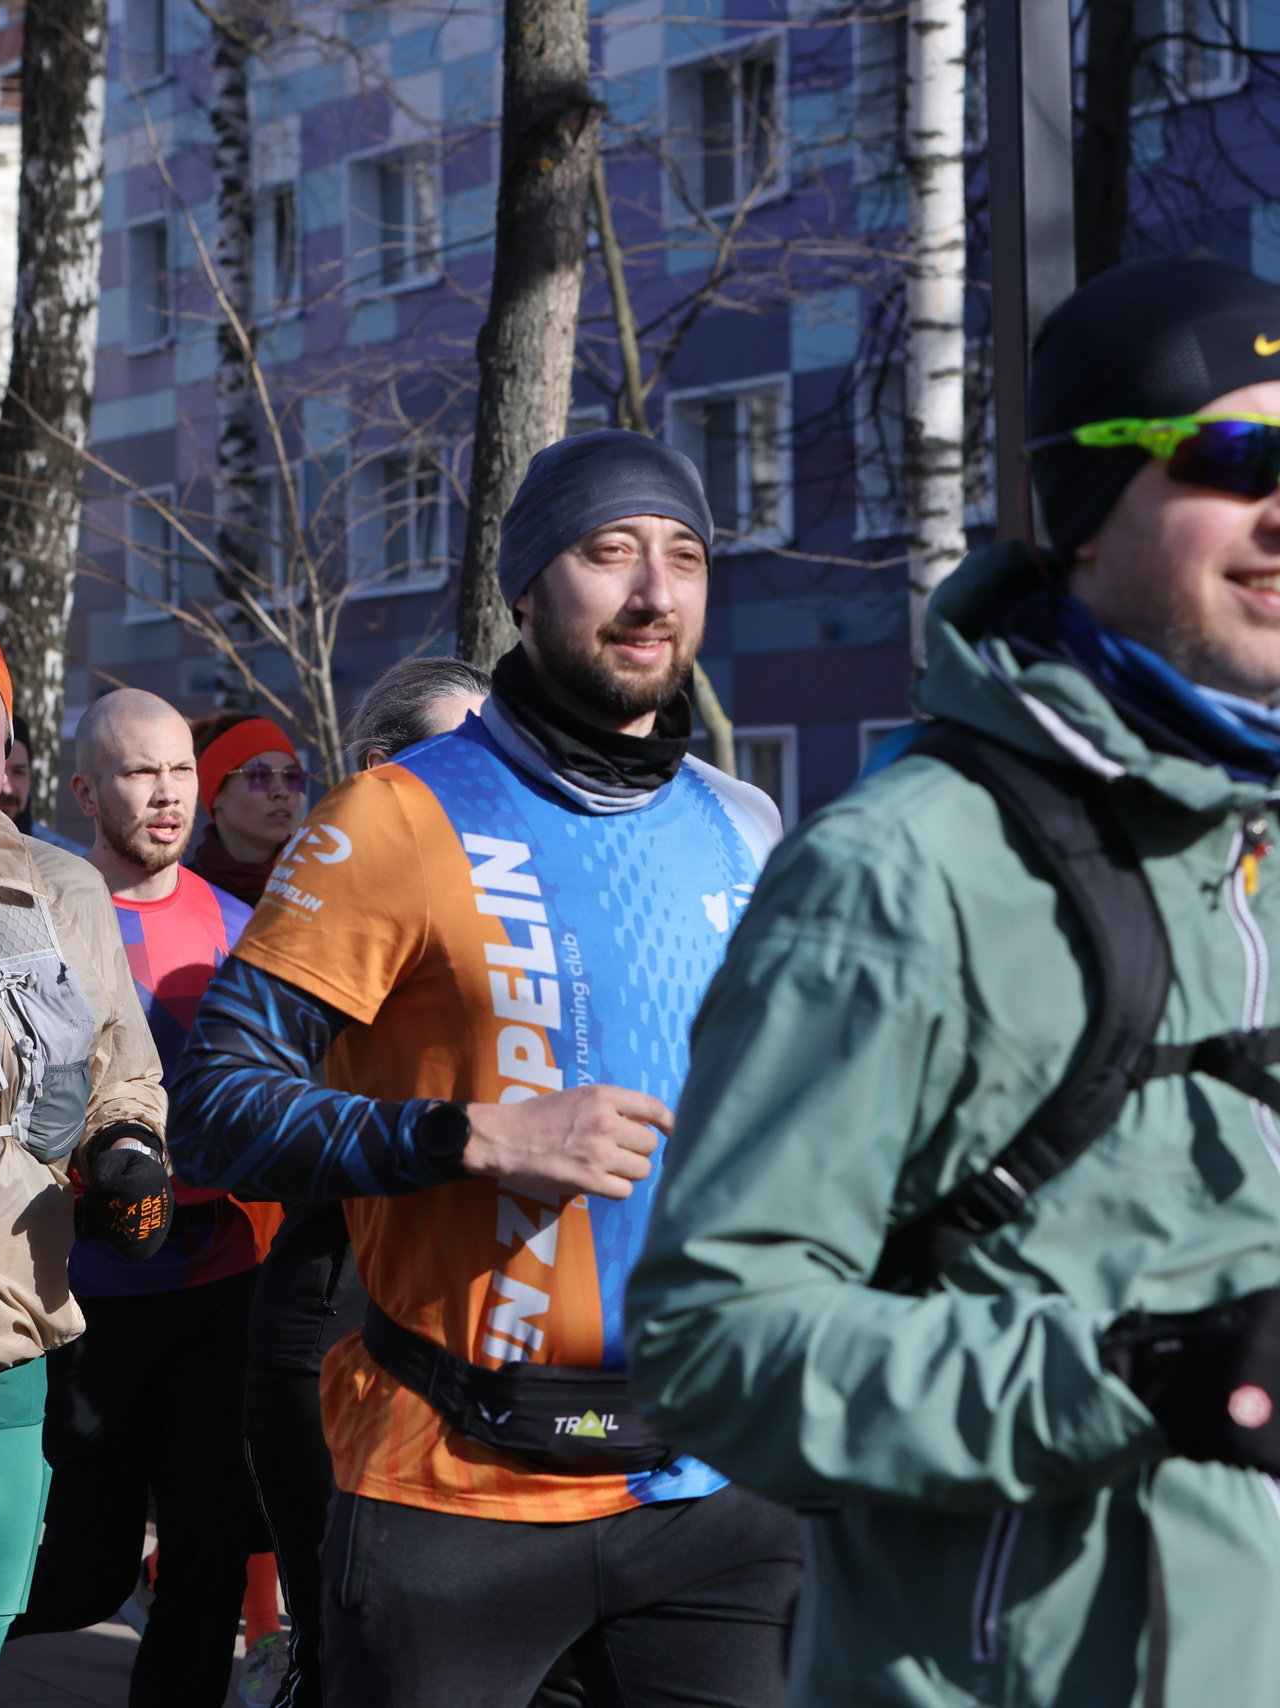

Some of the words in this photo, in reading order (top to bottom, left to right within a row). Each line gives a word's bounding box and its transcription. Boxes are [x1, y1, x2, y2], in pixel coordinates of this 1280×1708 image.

[561, 932, 583, 977] club
[569, 981, 590, 1065] running
[462, 832, 563, 1268] ZPELIN
[141, 1194, 152, 1216] FOX
[151, 1195, 161, 1230] ULTRA
[138, 1217, 152, 1240] MAD
[554, 1409, 619, 1439] TRAIL
